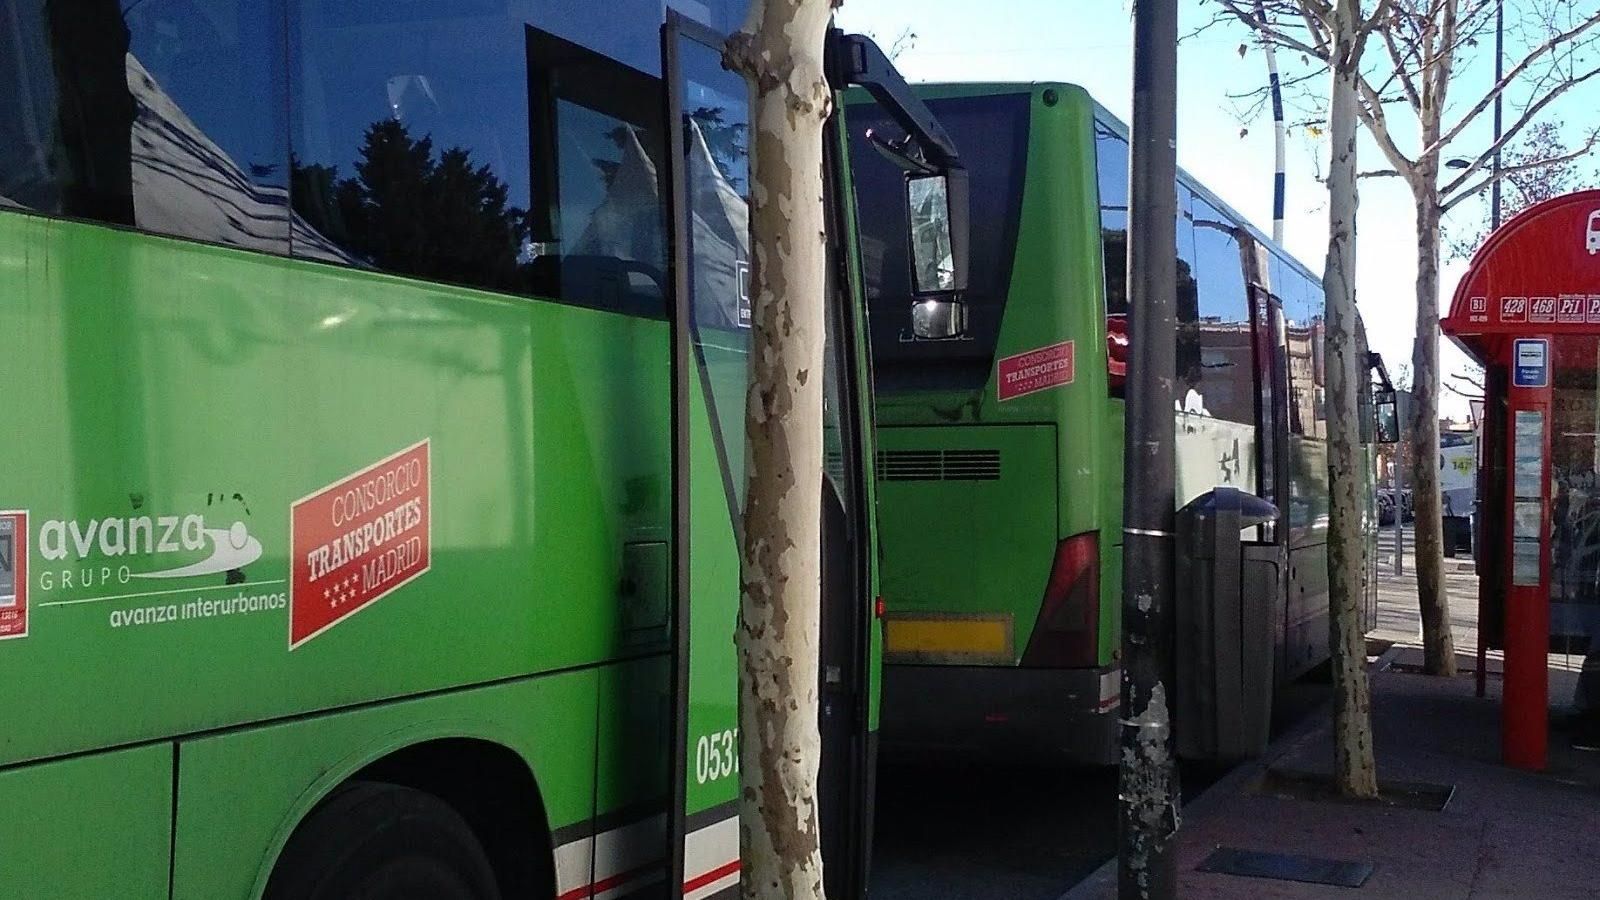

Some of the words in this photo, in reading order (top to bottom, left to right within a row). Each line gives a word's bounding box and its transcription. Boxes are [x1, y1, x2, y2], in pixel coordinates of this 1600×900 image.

[1503, 299, 1525, 313] 428
[1532, 299, 1554, 313] 468
[1006, 358, 1070, 383] TRANSPORTES
[332, 458, 421, 527] CONSORCIO
[39, 514, 205, 560] avanza
[308, 496, 421, 582] TRANSPORTES
[40, 565, 131, 590] GRUPO
[362, 536, 421, 594] MADRID
[110, 604, 178, 628] avanza
[182, 592, 286, 619] interurbanos
